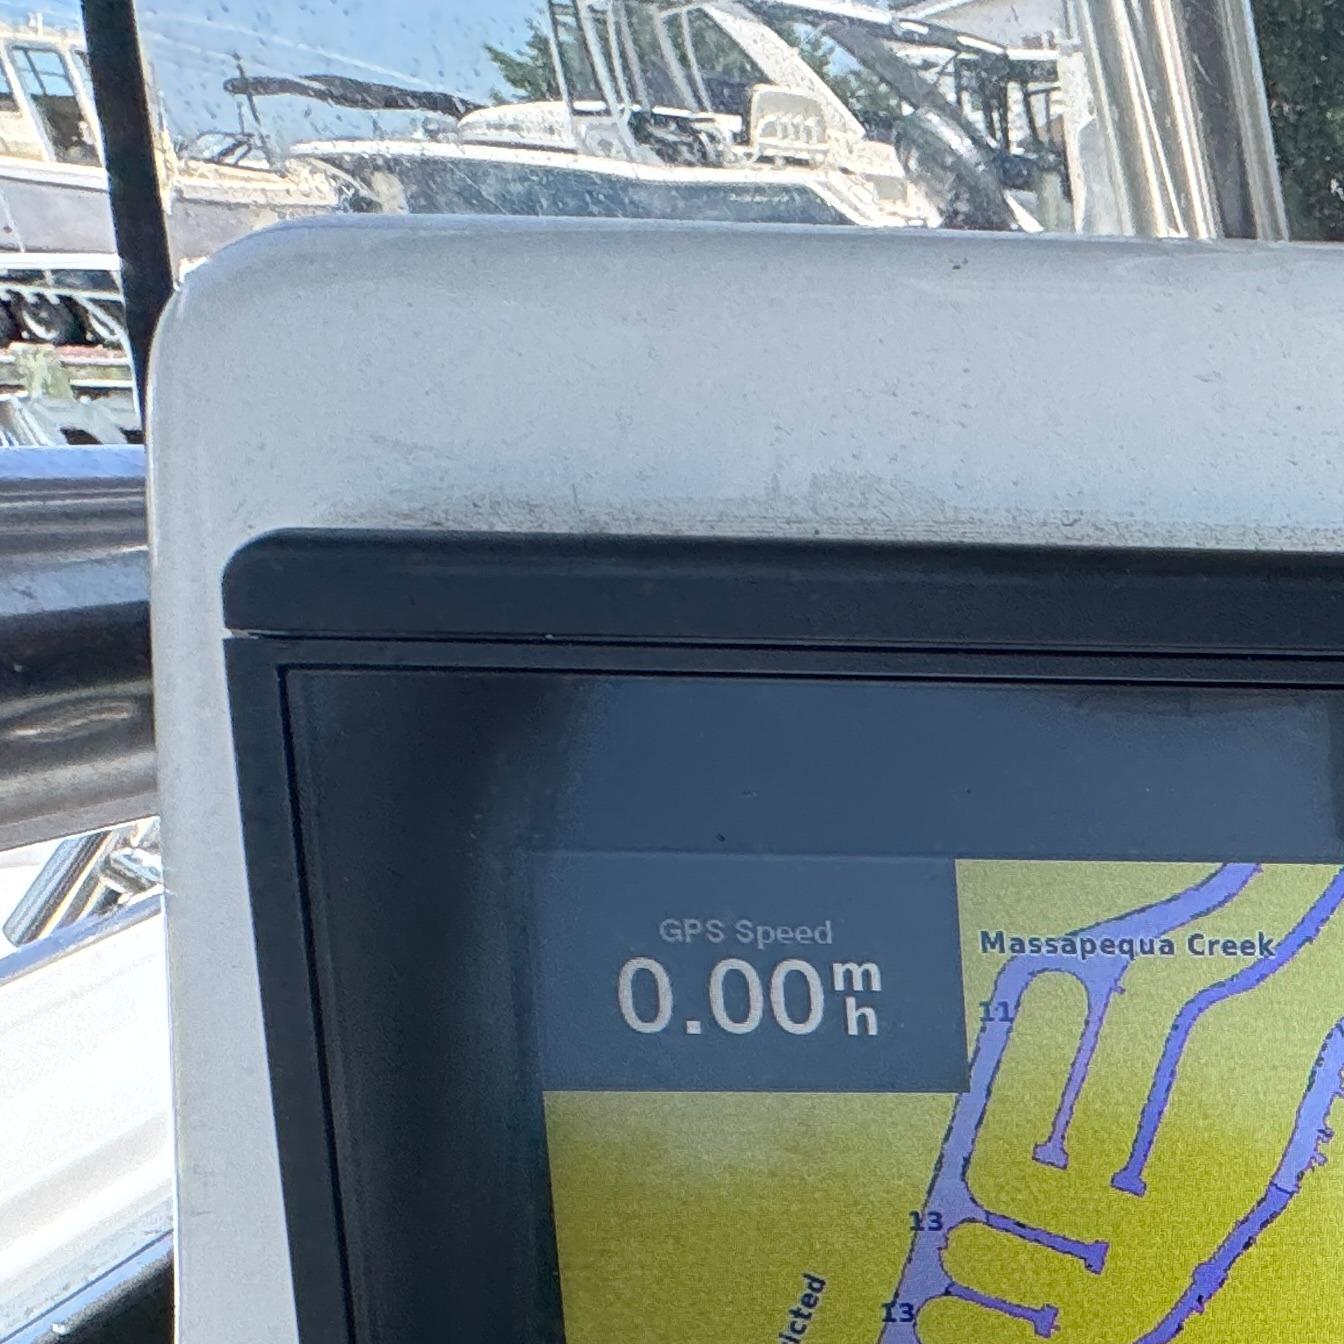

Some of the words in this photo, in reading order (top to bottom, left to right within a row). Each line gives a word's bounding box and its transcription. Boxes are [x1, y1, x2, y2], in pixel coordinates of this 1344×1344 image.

[659, 919, 725, 944] GPS
[735, 919, 833, 949] Speed
[980, 931, 1175, 958] Massapequa
[1188, 931, 1276, 957] Creek
[618, 956, 825, 1036] 0.00
[980, 1001, 1014, 1023] 11
[909, 1211, 943, 1232] 13
[882, 1302, 915, 1323] 13
